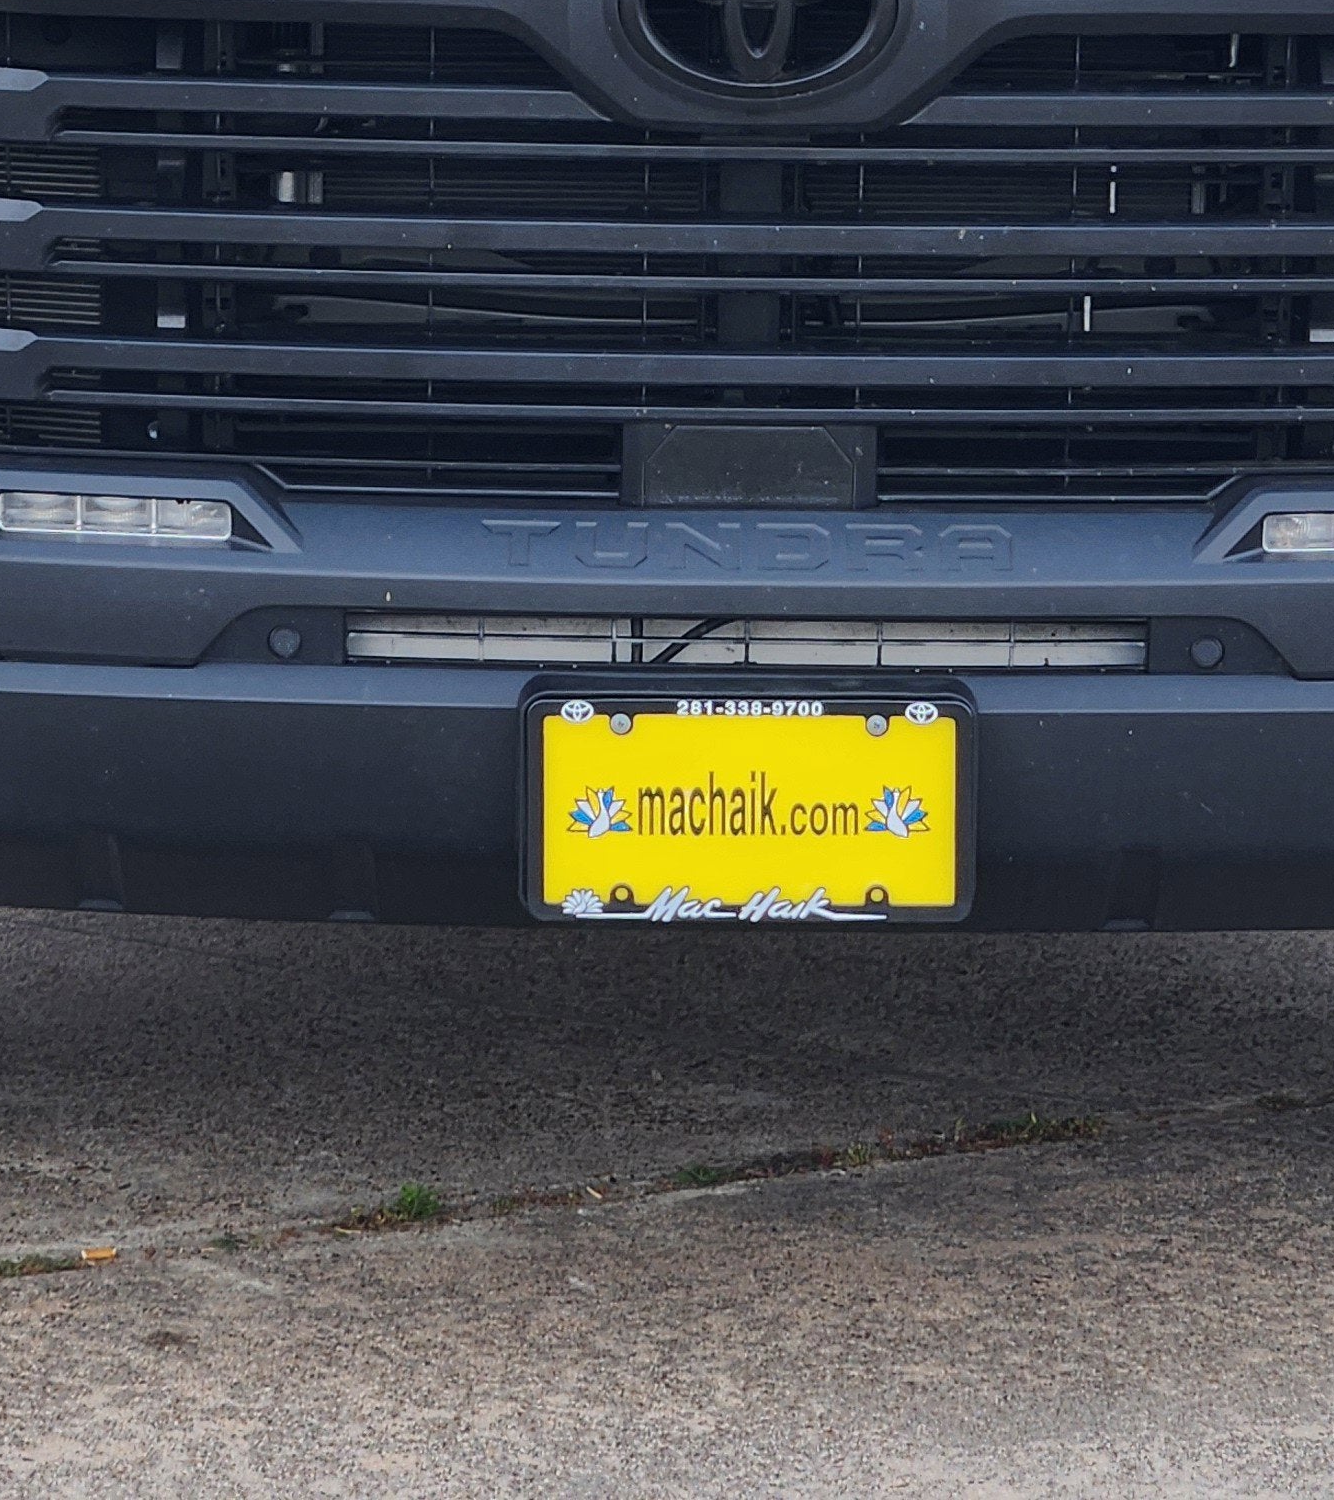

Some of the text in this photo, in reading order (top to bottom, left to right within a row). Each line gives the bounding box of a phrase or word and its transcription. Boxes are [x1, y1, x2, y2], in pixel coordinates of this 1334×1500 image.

[480, 518, 1015, 572] TUNDRA
[676, 700, 824, 717] 281-338-9700
[637, 770, 860, 837] machaik.com
[629, 886, 865, 922] Mac Haik
